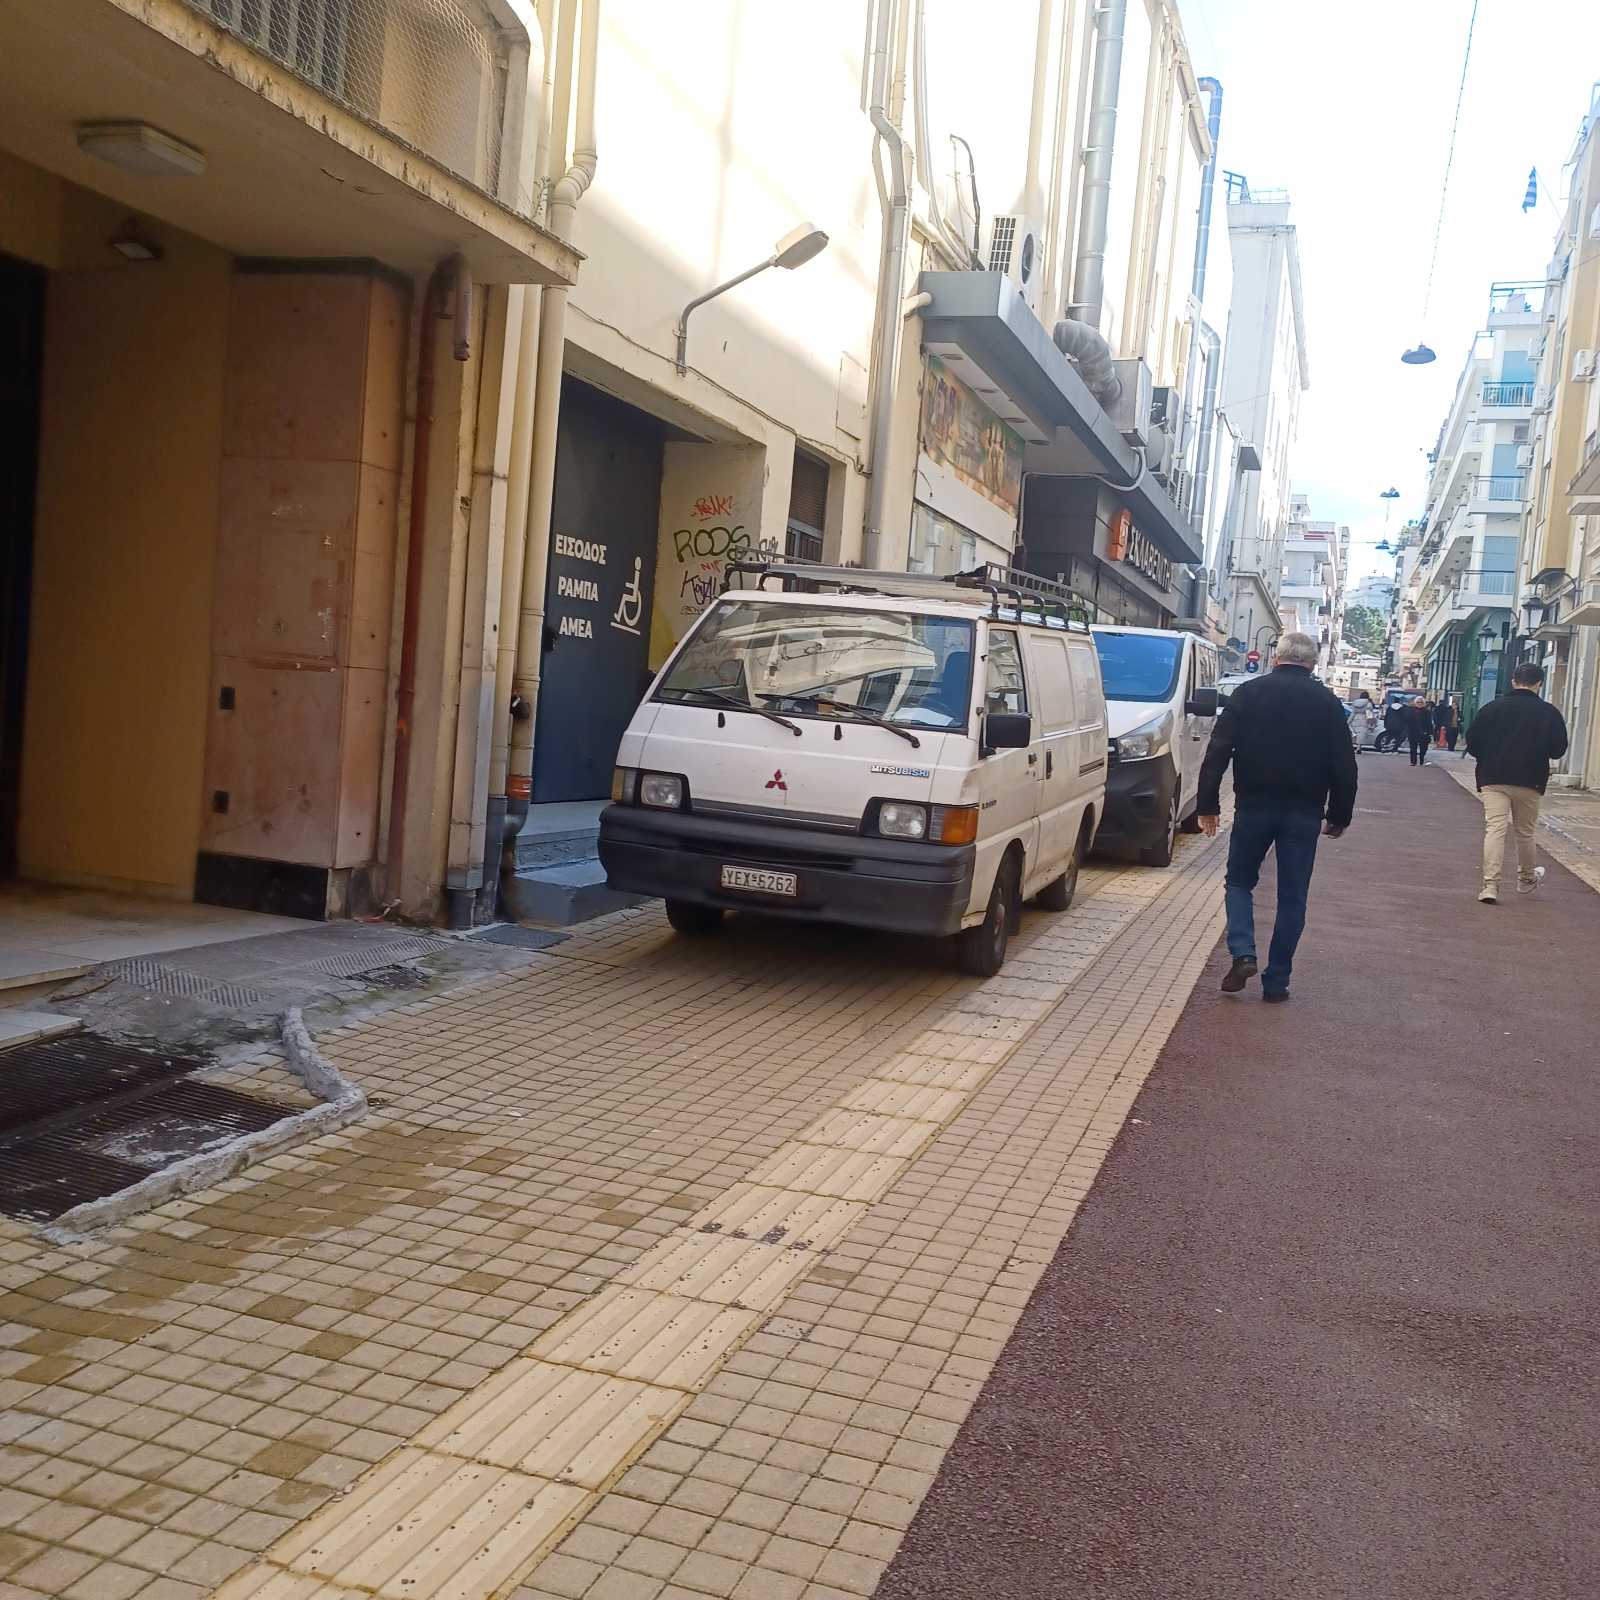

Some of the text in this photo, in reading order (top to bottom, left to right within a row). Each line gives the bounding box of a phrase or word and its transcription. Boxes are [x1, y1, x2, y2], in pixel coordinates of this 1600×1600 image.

[556, 533, 607, 565] ΕΙΣΟΔΟΣ
[558, 575, 599, 602] ΡΑΜΠΑ
[559, 616, 593, 639] ΑΜΕΑ
[870, 764, 930, 778] MITSUBISHI
